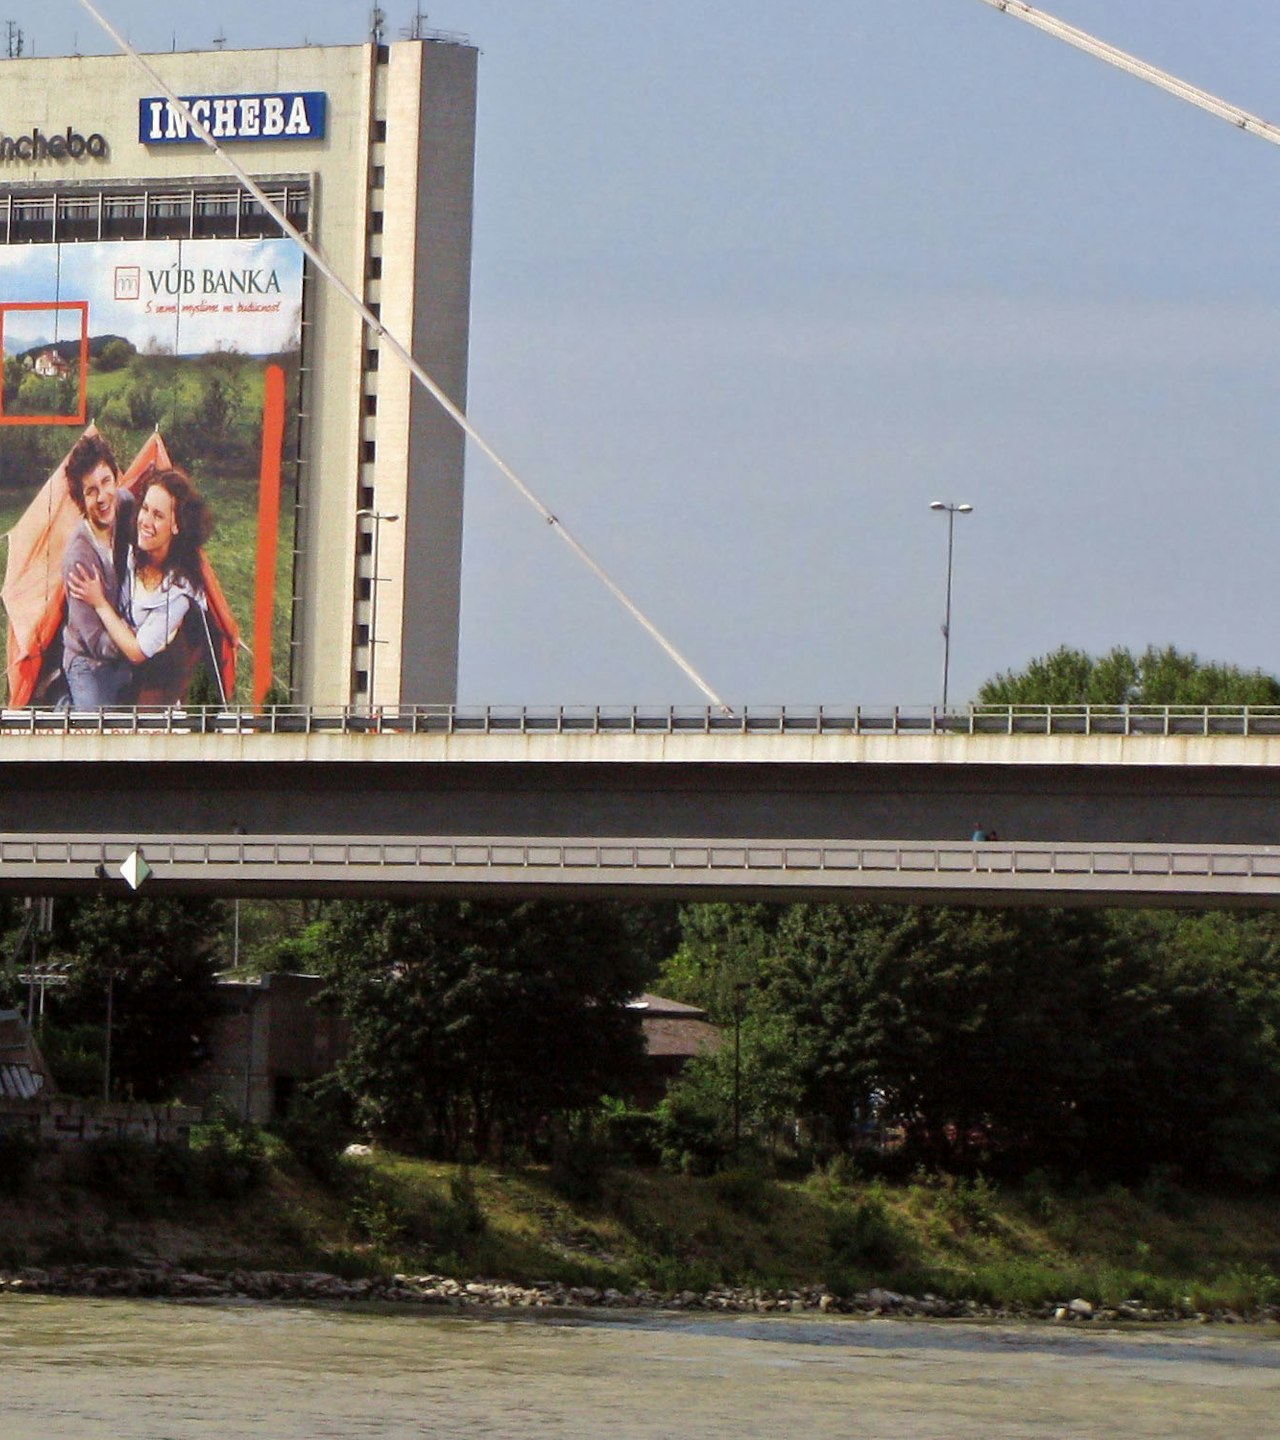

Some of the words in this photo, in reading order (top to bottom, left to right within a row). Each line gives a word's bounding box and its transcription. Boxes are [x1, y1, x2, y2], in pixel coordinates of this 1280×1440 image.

[150, 97, 311, 140] INCHEBA
[148, 263, 196, 295] VÚB
[203, 268, 282, 294] BANKA
